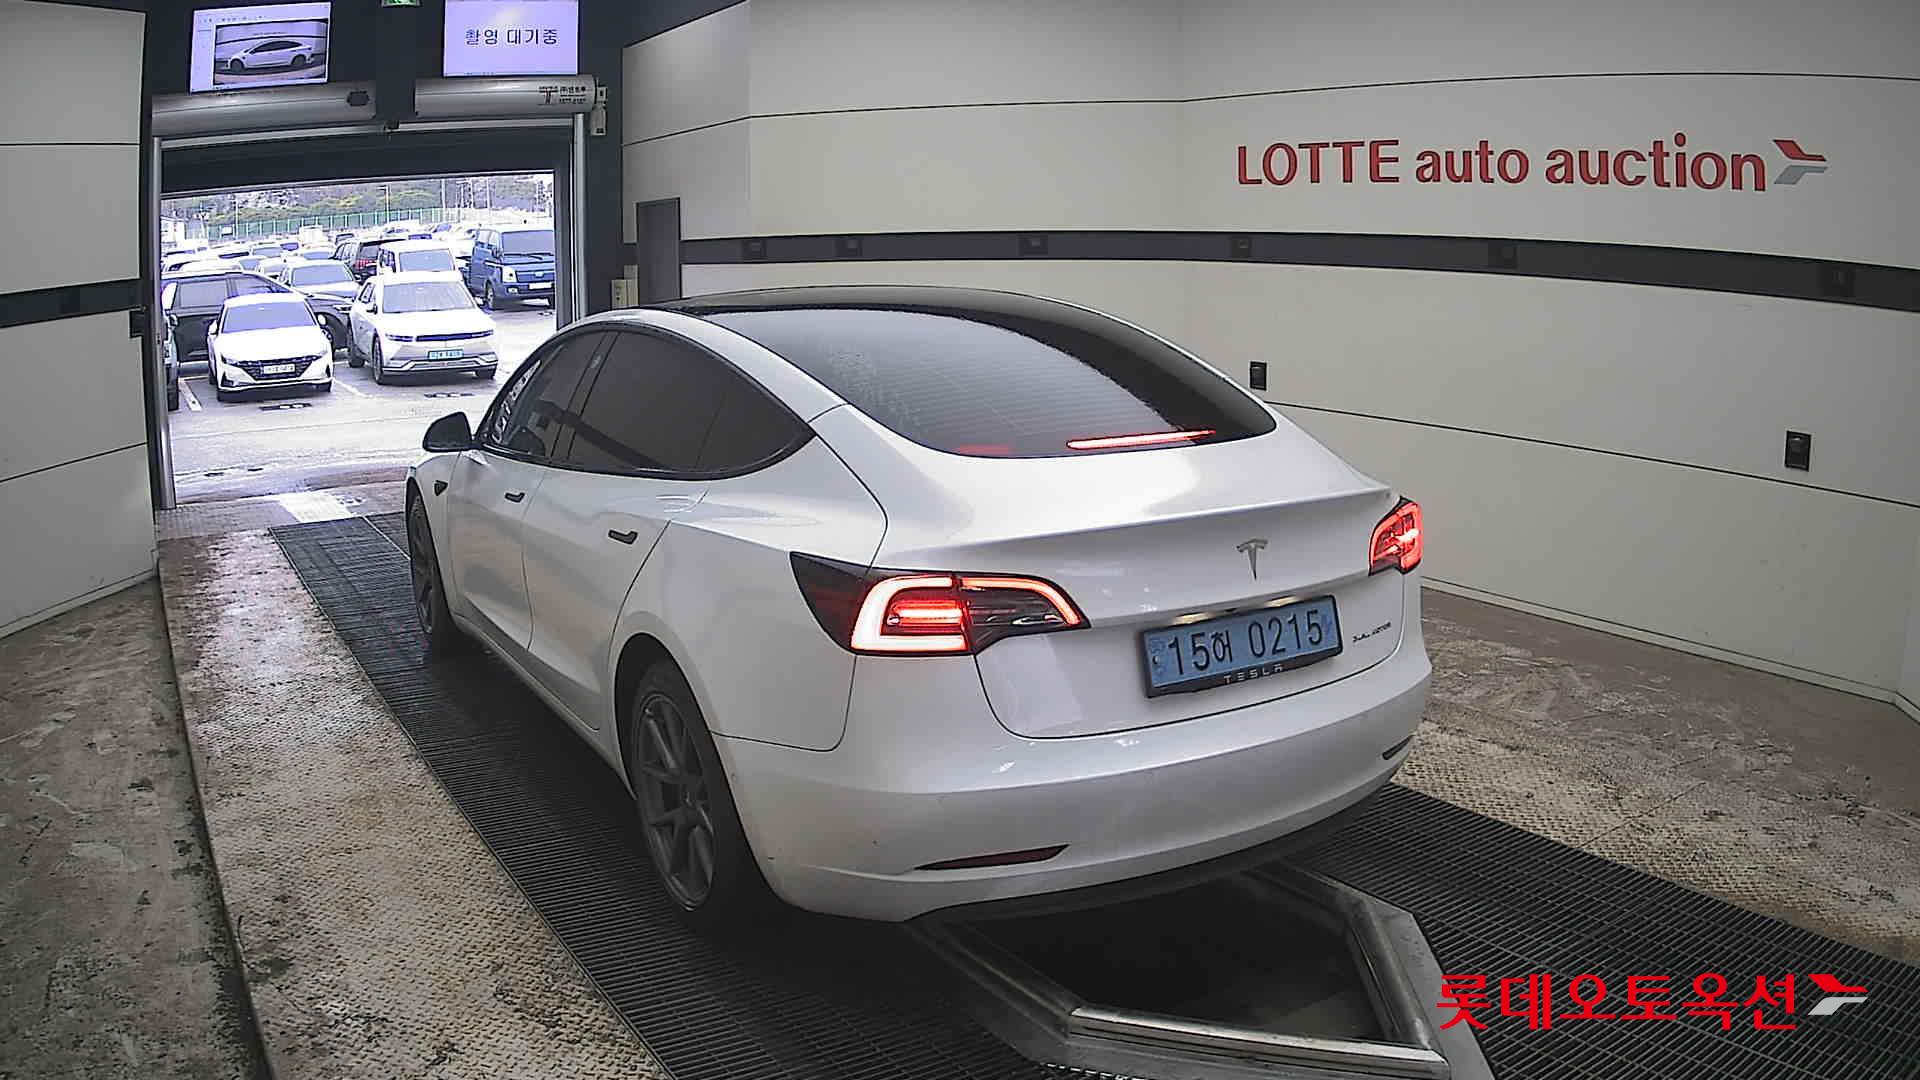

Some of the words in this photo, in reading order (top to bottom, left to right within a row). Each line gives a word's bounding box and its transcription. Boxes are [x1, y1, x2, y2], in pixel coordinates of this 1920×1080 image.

[465, 28, 498, 46] 촬영
[506, 28, 557, 45] 대기중
[1237, 139, 1400, 186] LOTTE
[1415, 139, 1530, 184] auto
[1545, 132, 1766, 192] auction
[1168, 629, 1234, 676] 15허
[1247, 609, 1324, 659] 0215
[1223, 663, 1284, 685] TESLA
